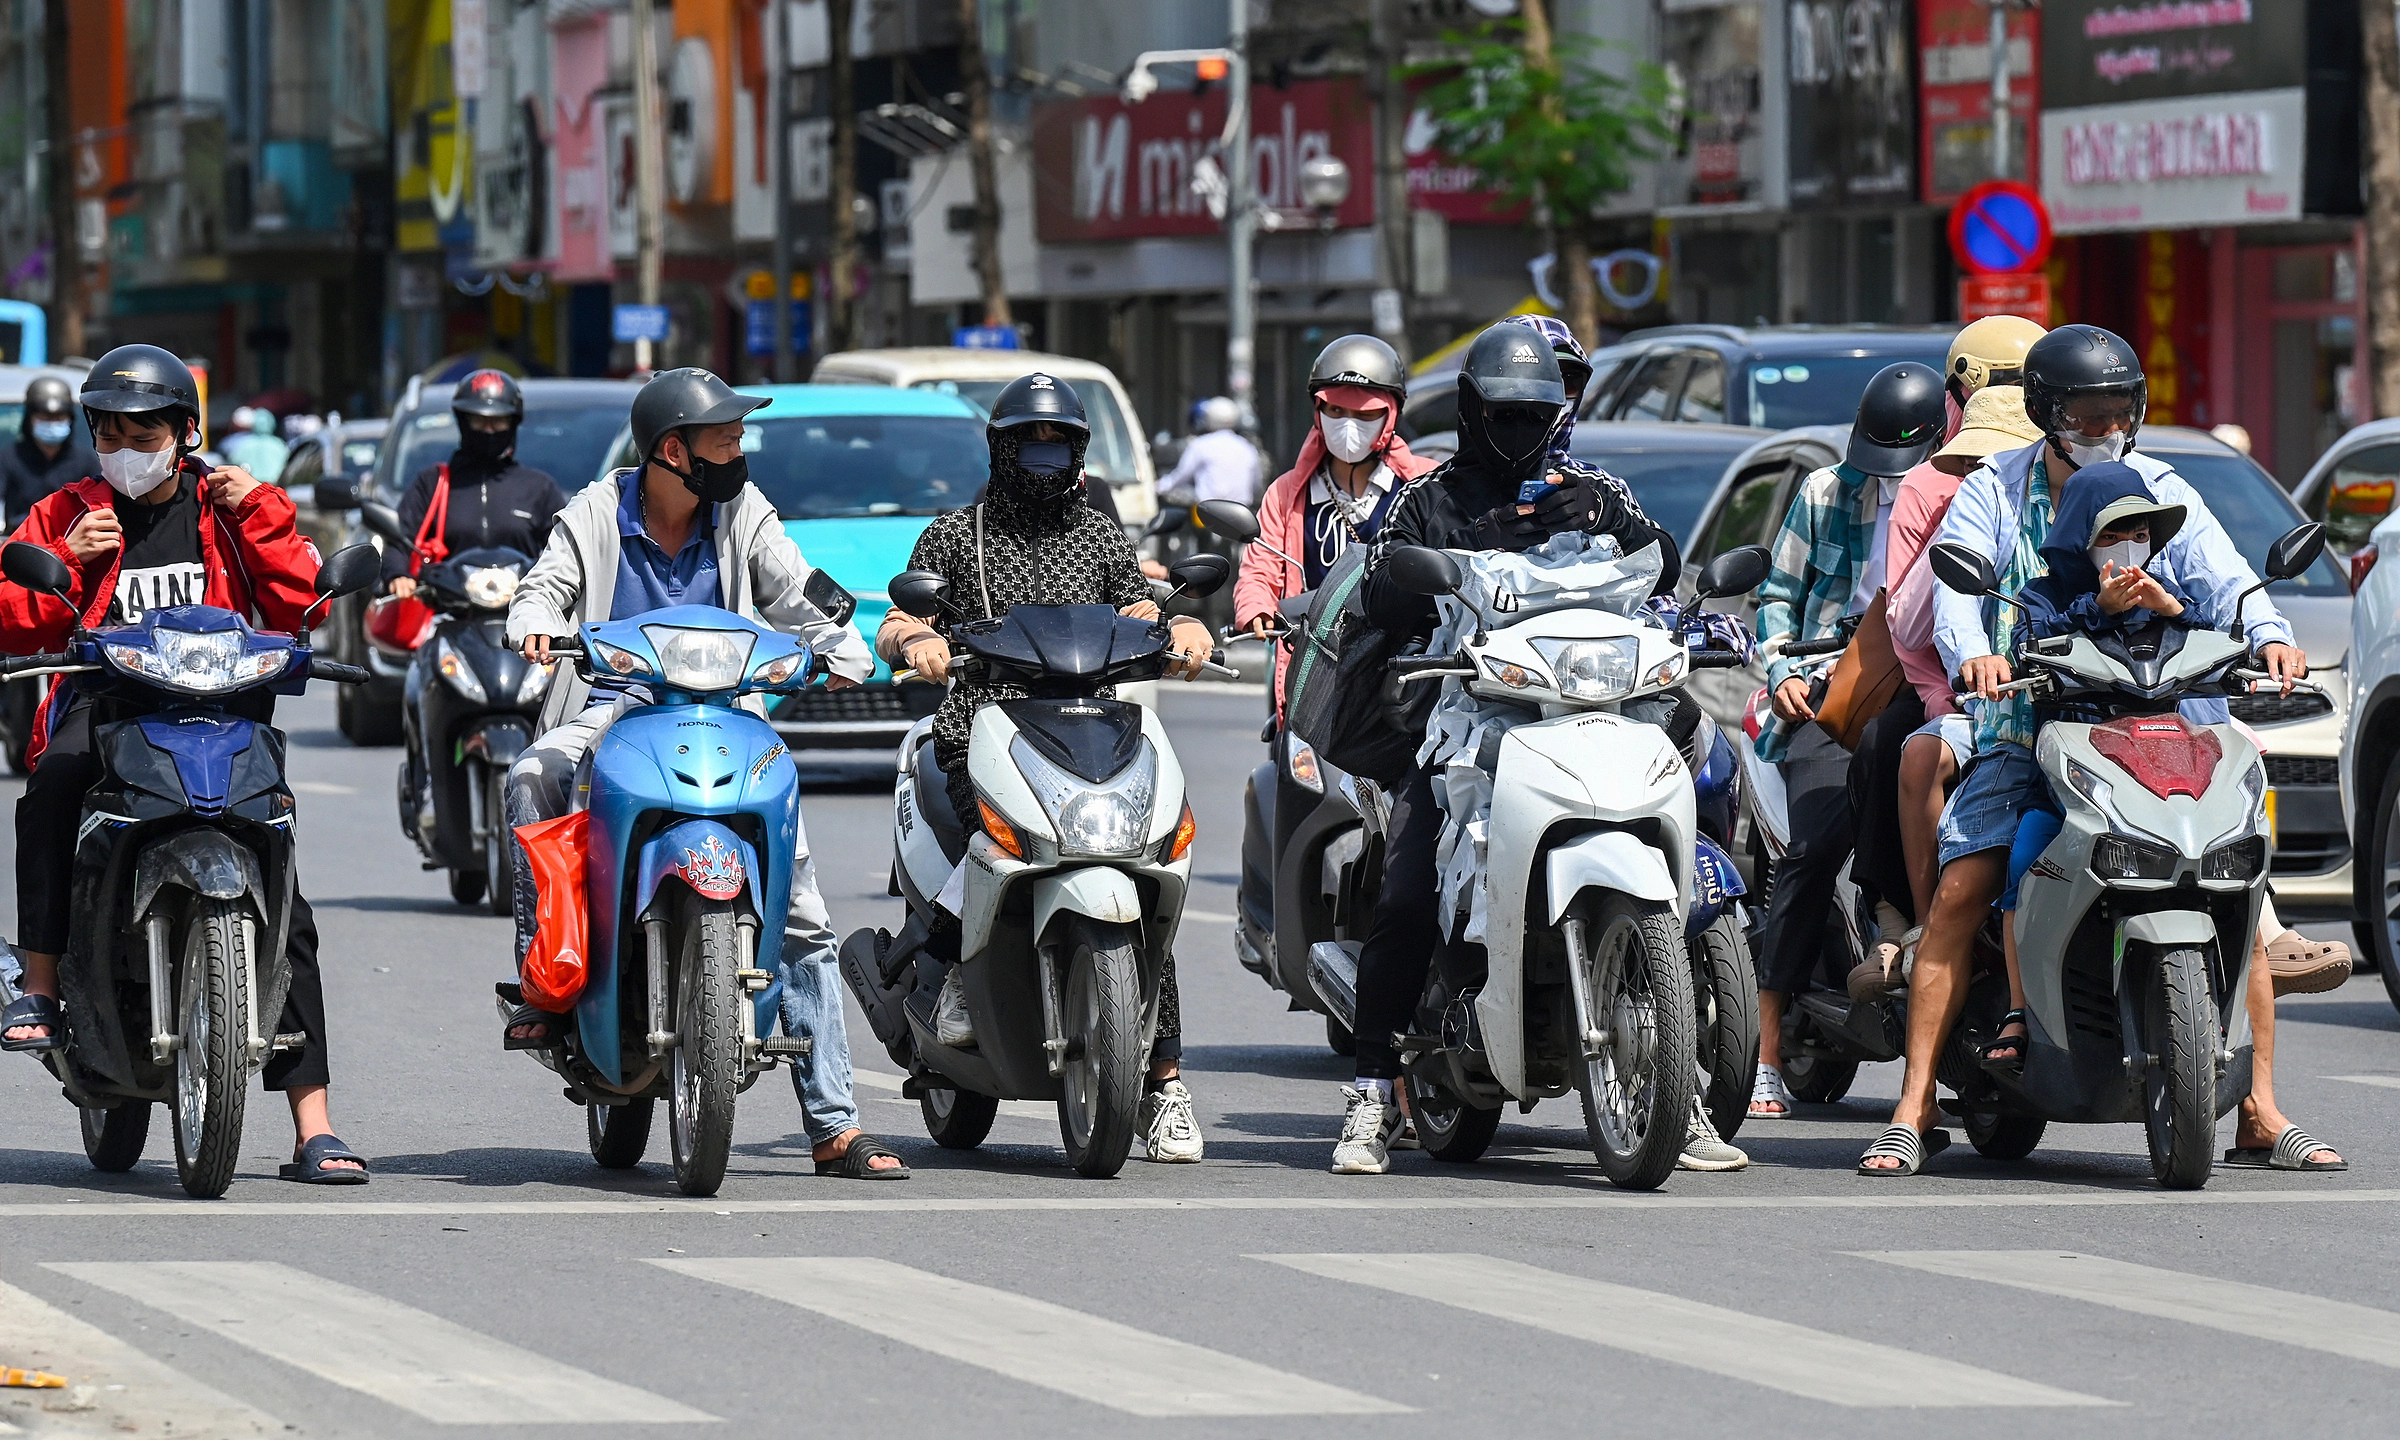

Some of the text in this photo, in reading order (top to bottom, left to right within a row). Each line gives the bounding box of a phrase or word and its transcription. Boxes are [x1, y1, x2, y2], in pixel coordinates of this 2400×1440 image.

[1511, 356, 1539, 364] adidas
[1332, 372, 1369, 383] Andes
[1060, 705, 1104, 714] HONDA
[179, 716, 220, 726] HONDA
[677, 721, 723, 730] HONDA
[1577, 717, 1618, 728] HONDA
[902, 789, 914, 834] CLICK
[80, 815, 100, 836] HONDA
[969, 851, 995, 877] HONDA
[2042, 856, 2066, 876] SPORT
